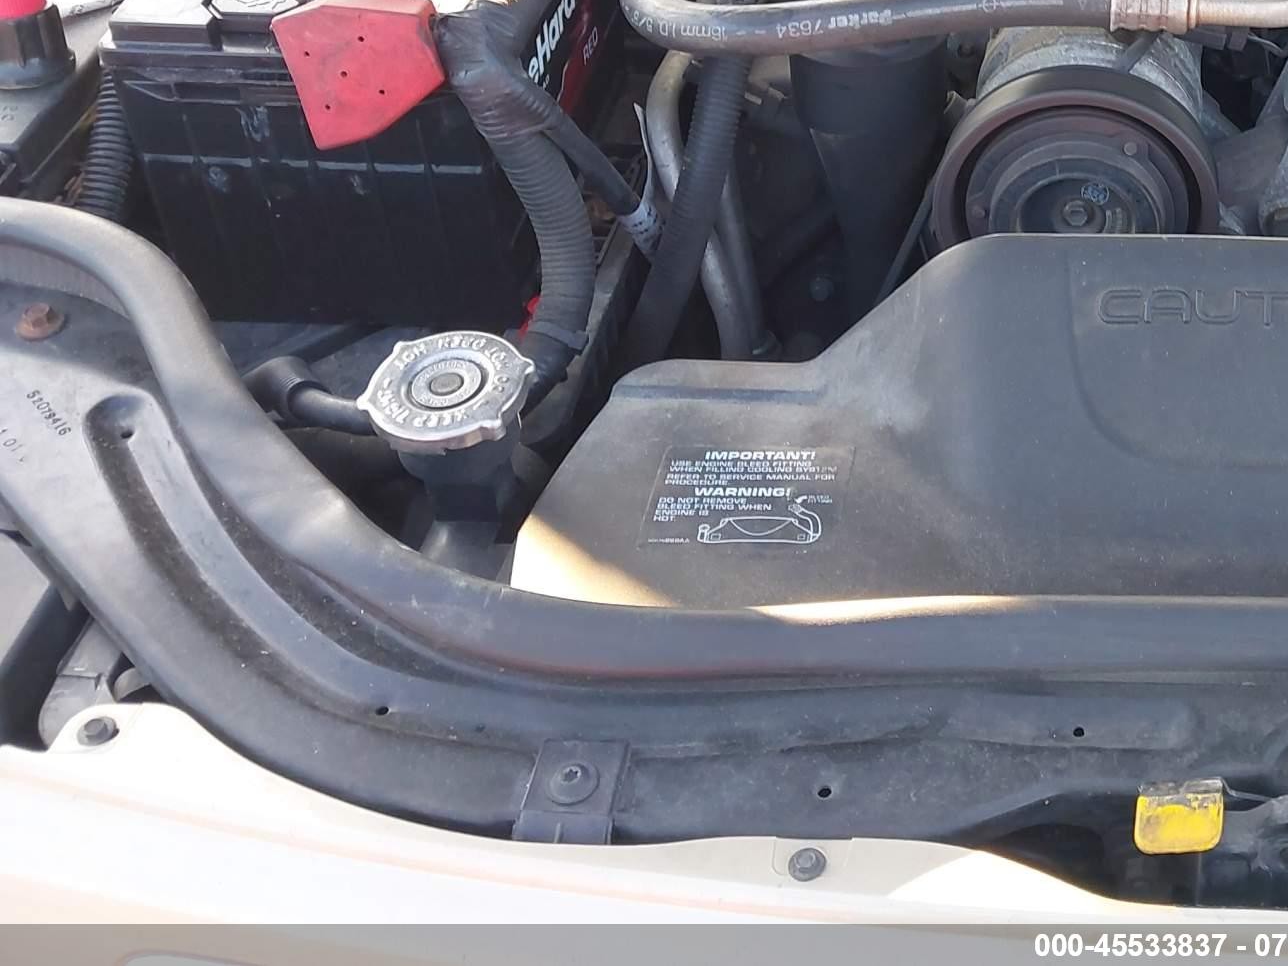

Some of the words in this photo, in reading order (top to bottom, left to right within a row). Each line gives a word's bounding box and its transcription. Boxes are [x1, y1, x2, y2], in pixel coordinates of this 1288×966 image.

[828, 9, 893, 29] Parker
[776, 20, 824, 39] 7634
[705, 450, 816, 460] IMPORTANT!
[772, 460, 812, 468] FITTING
[694, 487, 791, 497] WARNING!
[703, 497, 747, 505] REMOVE
